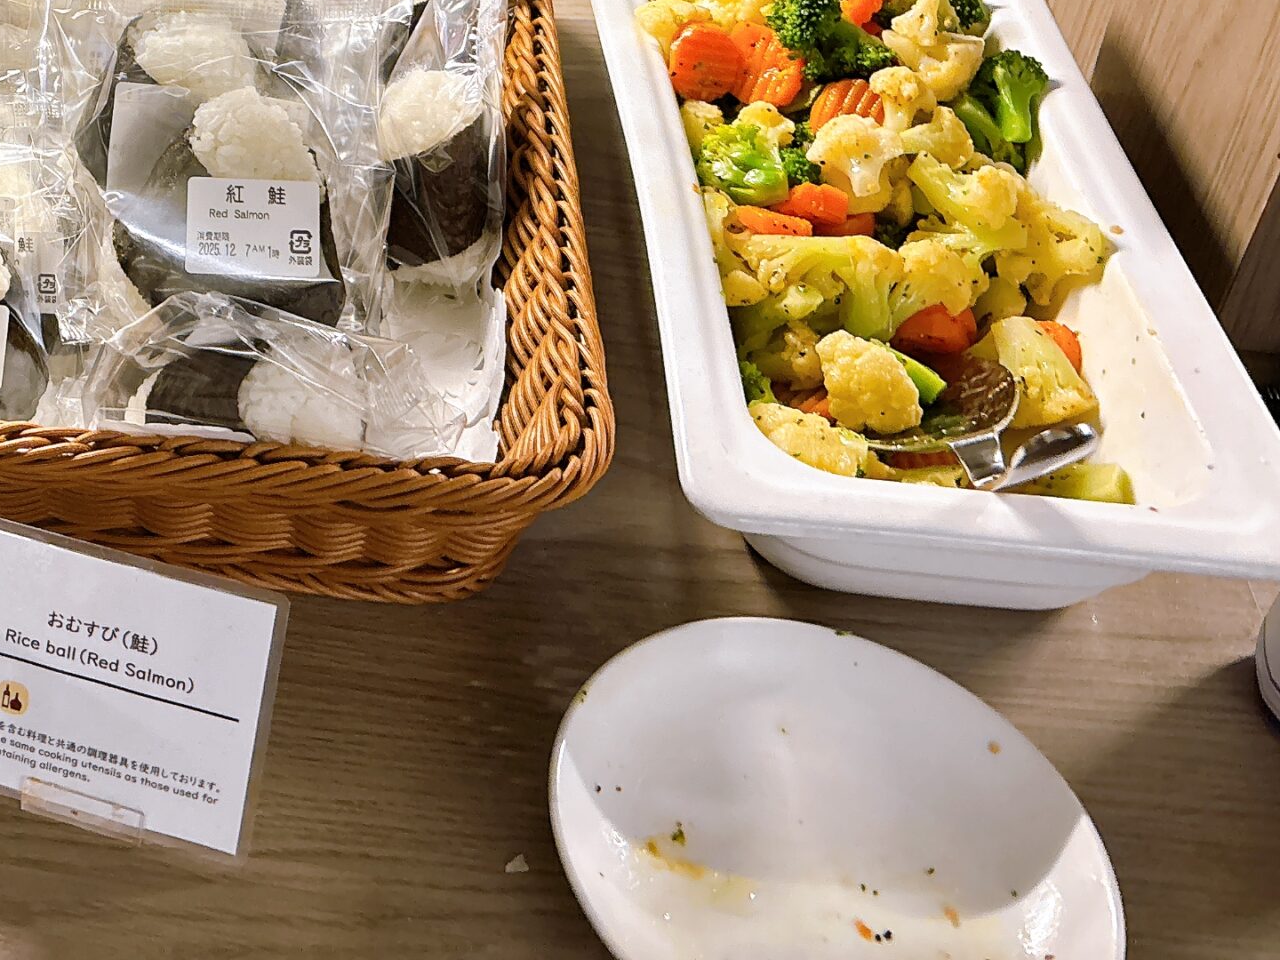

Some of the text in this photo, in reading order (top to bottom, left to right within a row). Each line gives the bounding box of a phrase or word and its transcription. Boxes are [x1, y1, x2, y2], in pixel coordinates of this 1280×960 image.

[209, 208, 270, 220] Red Salmon
[5, 628, 41, 650] Rice
[124, 662, 195, 694] Salmon)
[9, 739, 36, 753] same
[38, 748, 78, 767] cooking
[81, 760, 121, 779] utensils
[124, 773, 137, 783] as
[140, 777, 170, 792] those
[173, 787, 199, 800] used
[202, 793, 219, 805] for
[39, 761, 90, 782] allergens.
